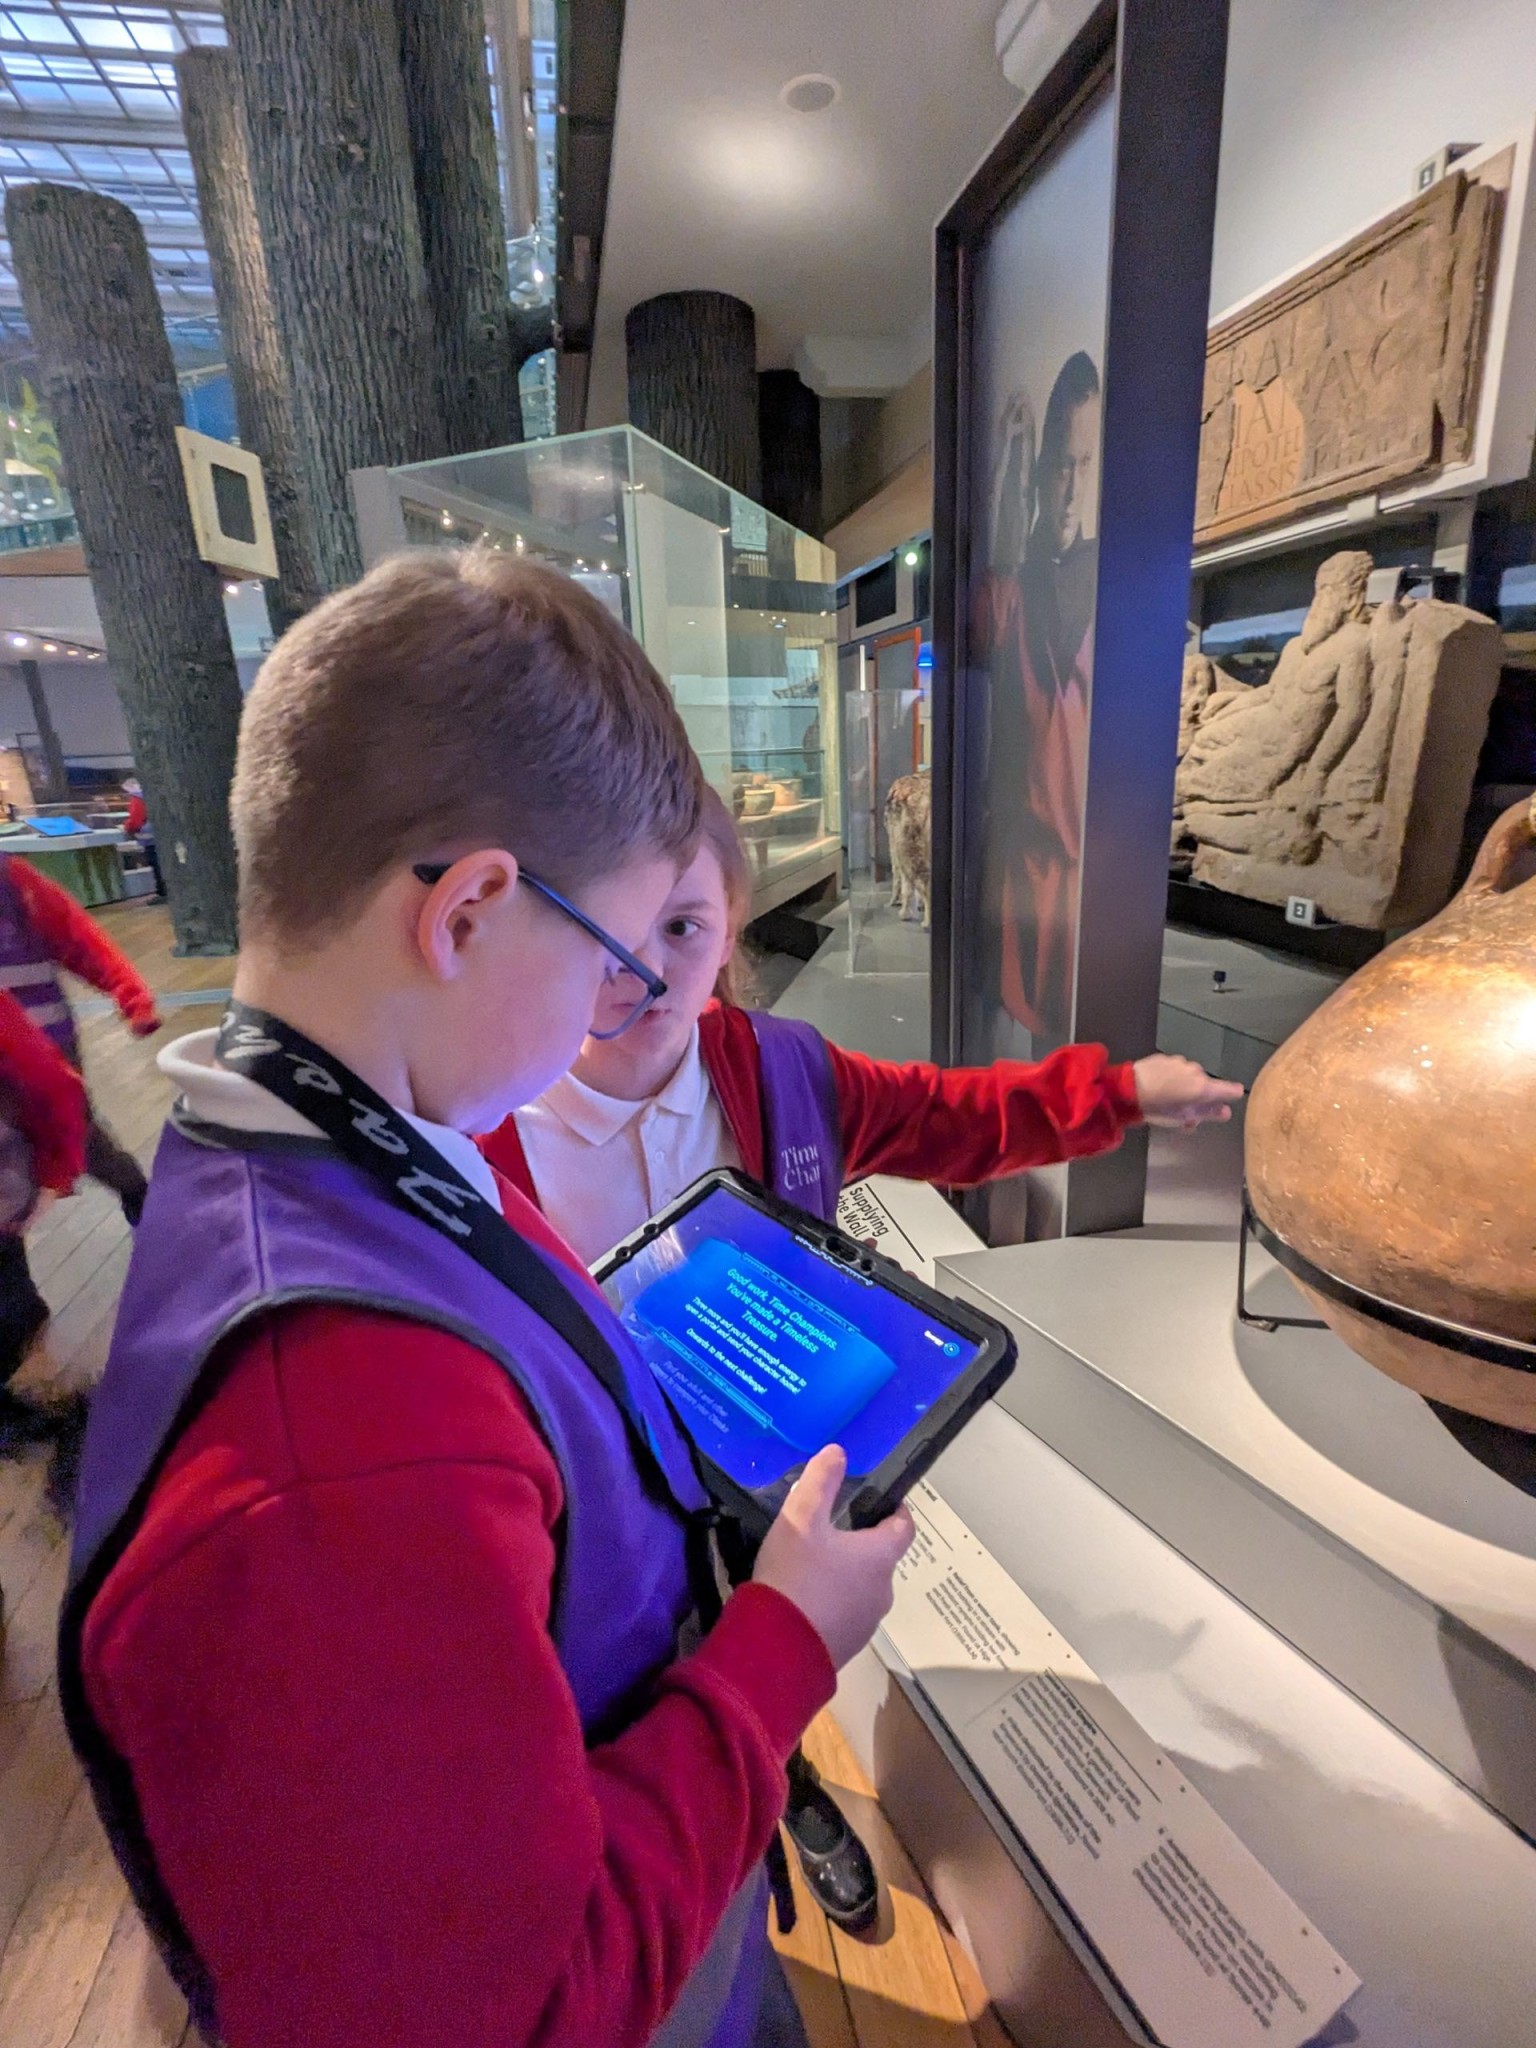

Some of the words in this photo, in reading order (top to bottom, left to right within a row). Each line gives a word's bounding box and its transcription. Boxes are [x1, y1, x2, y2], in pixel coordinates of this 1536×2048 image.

[1296, 905, 1304, 916] 2
[843, 1210, 870, 1237] Wall
[849, 1187, 889, 1237] Supplying
[692, 1295, 708, 1311] Three
[705, 1307, 722, 1321] more
[719, 1316, 733, 1329] and
[743, 1335, 759, 1350] have
[755, 1345, 781, 1368] enough
[776, 1363, 800, 1383] energy
[797, 1377, 808, 1388] to
[725, 1281, 753, 1305] You've
[749, 1299, 775, 1322] made
[771, 1316, 780, 1326] a
[779, 1320, 820, 1354] Timeless
[726, 1266, 750, 1287] Good
[745, 1281, 769, 1302] work,
[768, 1295, 791, 1316] Time
[787, 1309, 840, 1352] Champions.
[740, 1309, 780, 1342] Treasure.
[683, 1302, 699, 1317] open
[699, 1314, 719, 1332] portal
[715, 1327, 729, 1339] and
[726, 1335, 742, 1350] send
[738, 1345, 754, 1361] your
[751, 1354, 782, 1381] character
[778, 1375, 801, 1396] home!
[685, 1326, 711, 1349] Onwards
[707, 1344, 717, 1354] to
[713, 1349, 726, 1362] the
[722, 1357, 738, 1372] next
[733, 1366, 768, 1397] challenge!
